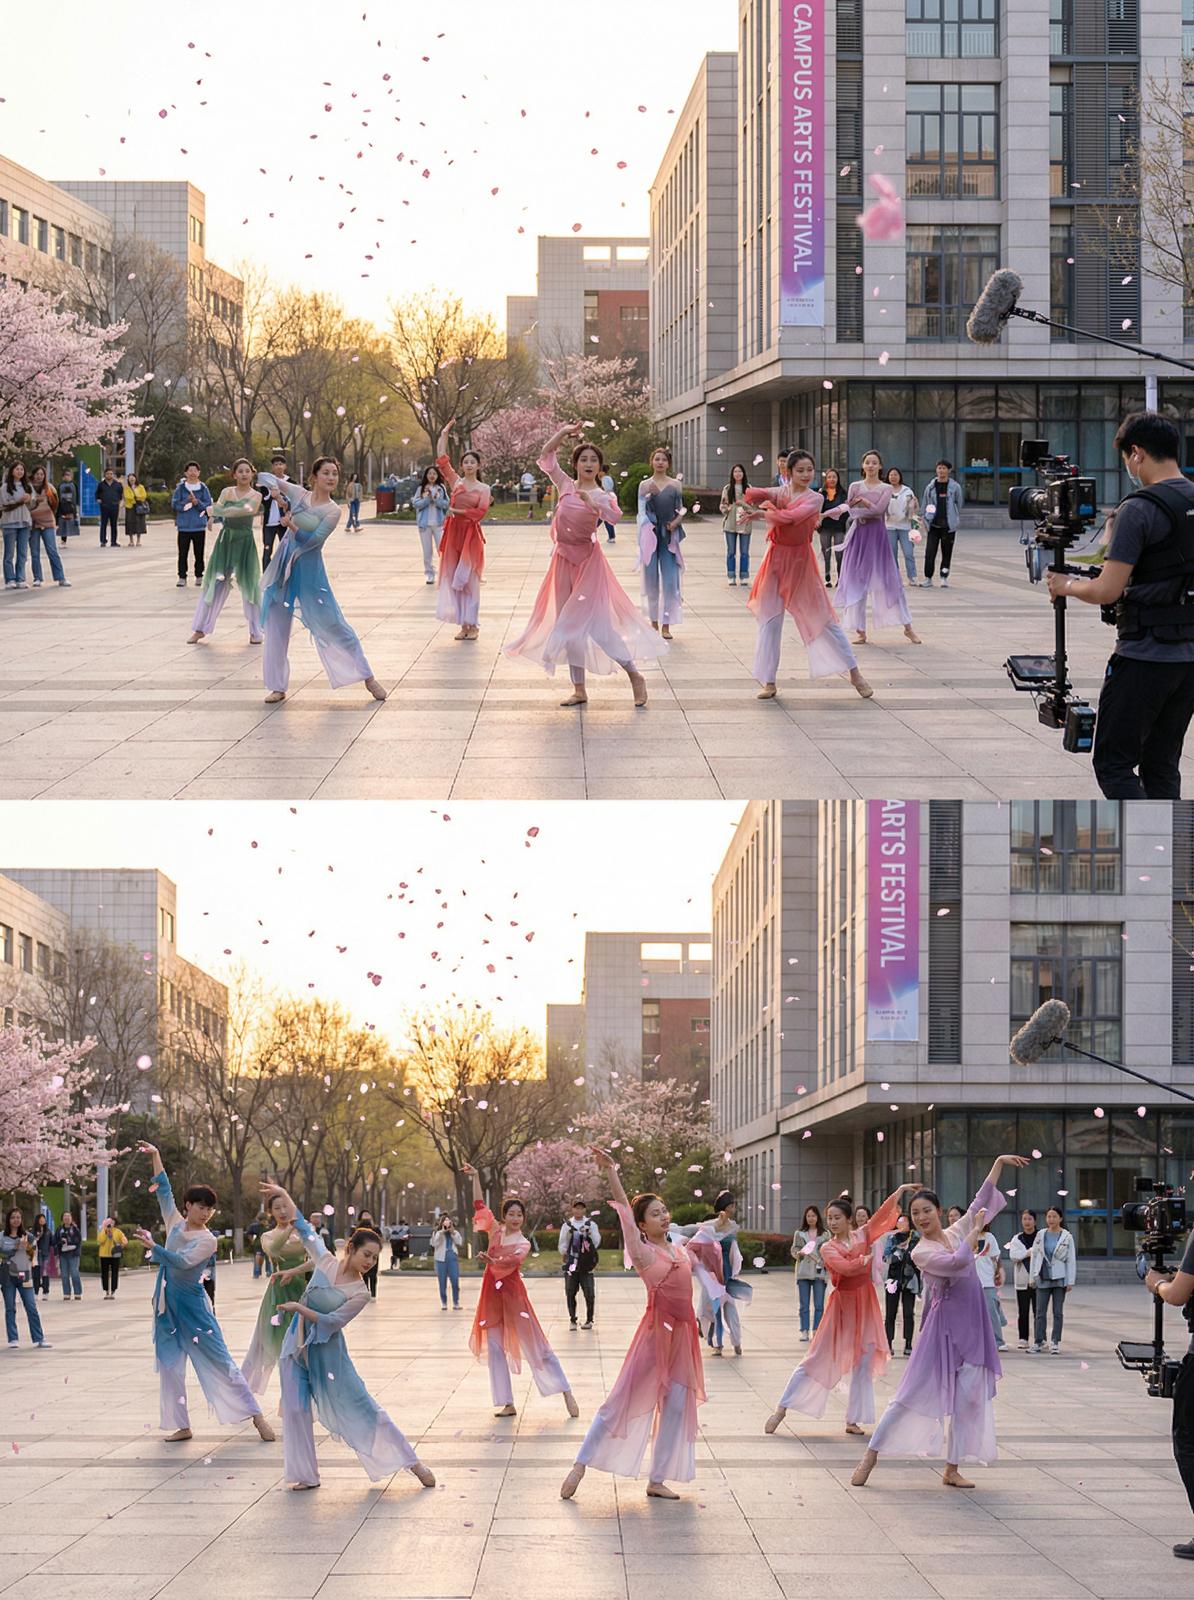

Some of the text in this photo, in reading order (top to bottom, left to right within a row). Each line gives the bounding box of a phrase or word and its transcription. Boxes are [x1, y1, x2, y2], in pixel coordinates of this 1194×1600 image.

[793, 3, 812, 272] CAMPUS ARTS FESTIVAL
[881, 799, 906, 968] ARTS FESTIVAL
